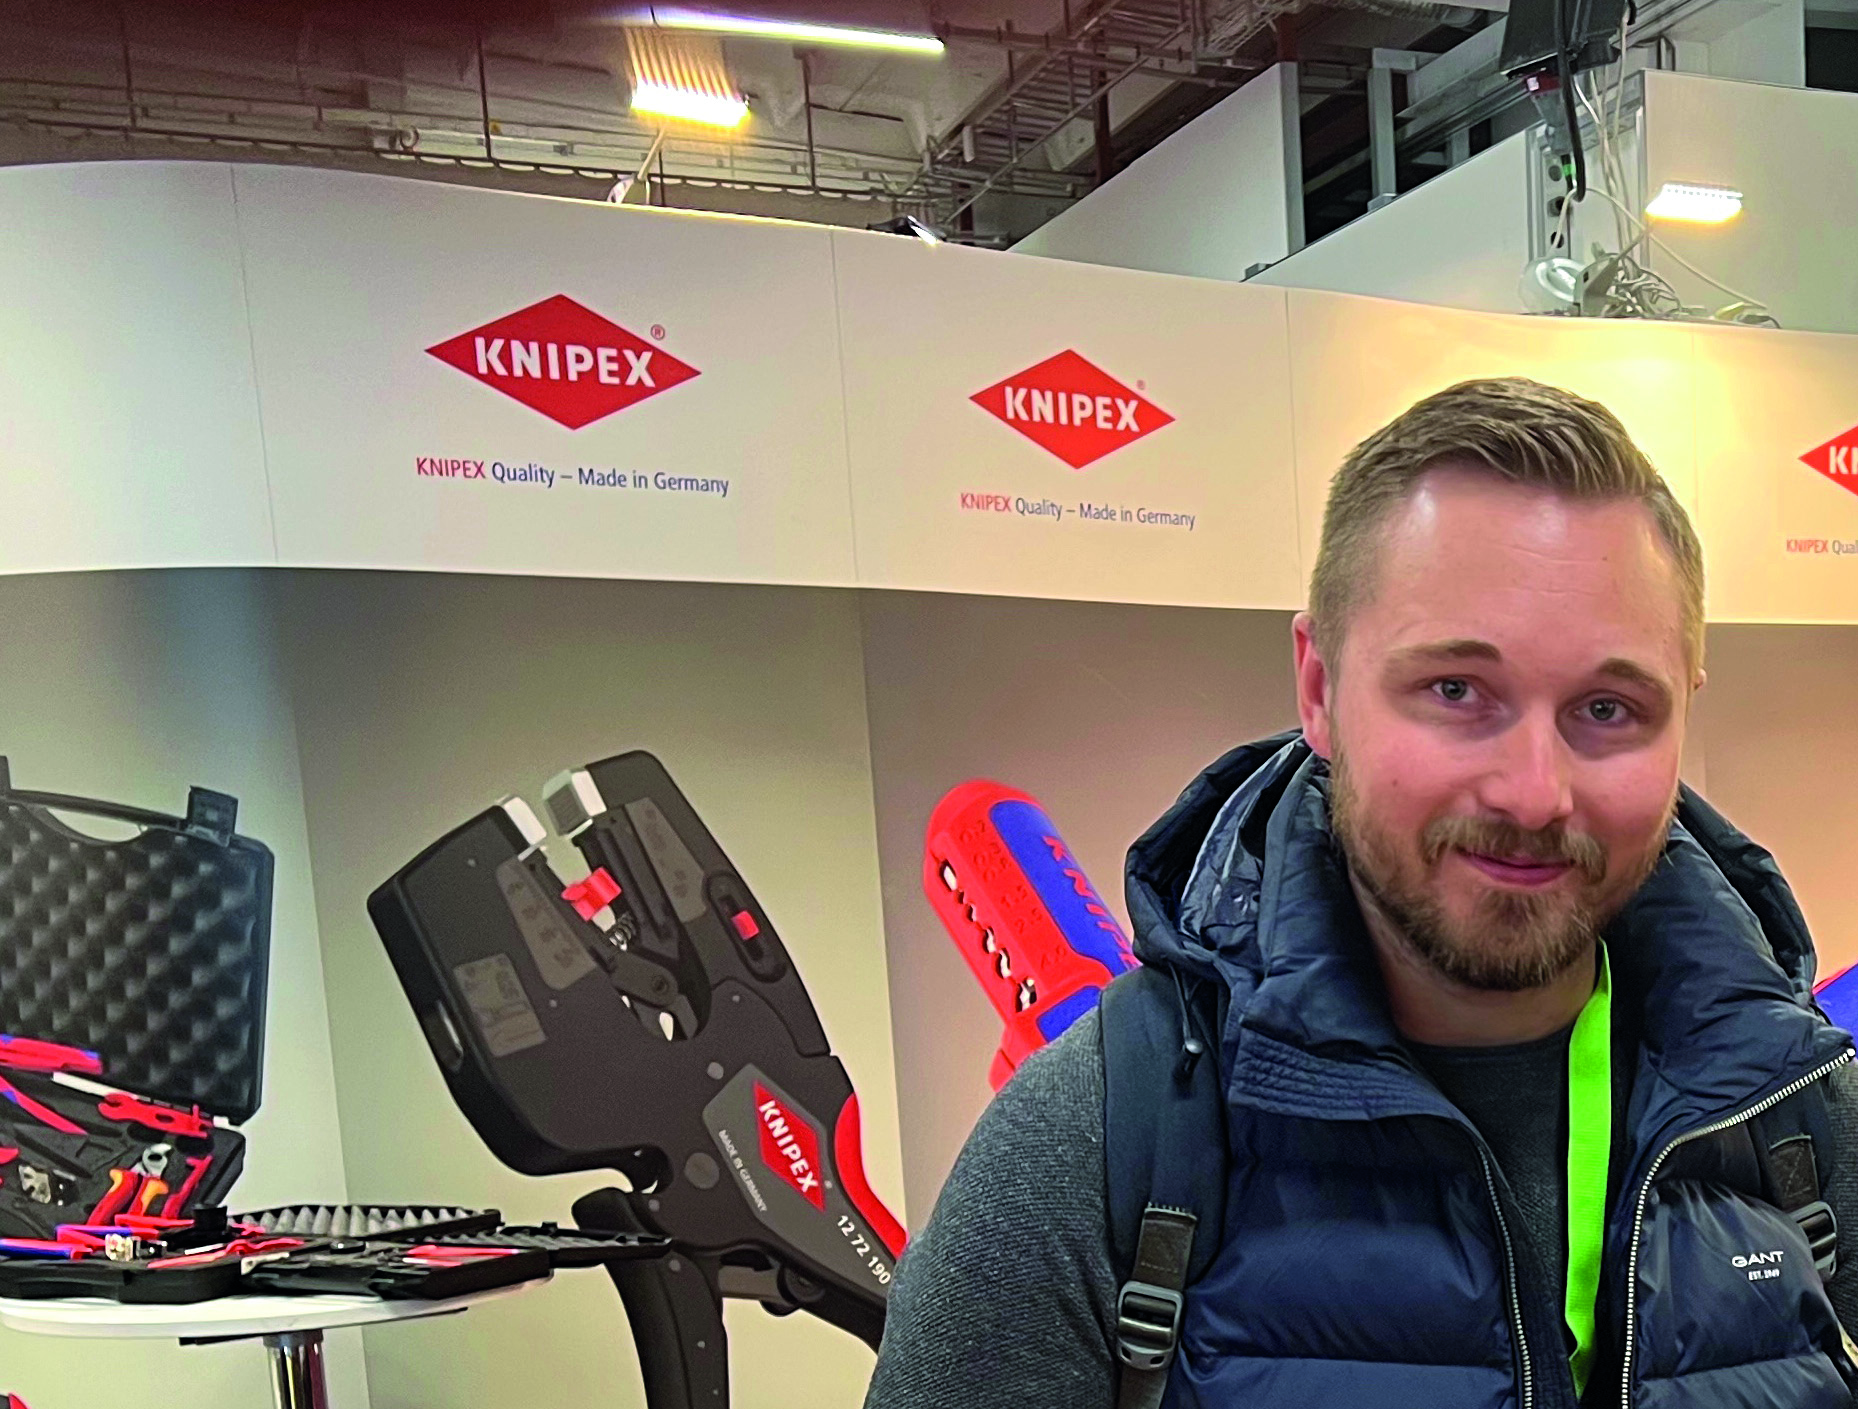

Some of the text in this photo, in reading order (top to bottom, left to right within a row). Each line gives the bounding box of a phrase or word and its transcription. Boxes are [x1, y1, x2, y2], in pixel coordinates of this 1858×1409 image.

[474, 336, 656, 387] KNIPEX
[1004, 385, 1140, 432] KNIPEX
[416, 457, 486, 479] KNIPEX
[491, 461, 555, 488] Quality
[578, 467, 627, 488] Made
[632, 469, 648, 489] in
[654, 471, 729, 498] Germany
[960, 492, 1012, 513] KNIPEX
[1015, 498, 1062, 522] Quality
[1079, 503, 1116, 521] Made
[1121, 505, 1133, 523] in
[1137, 507, 1196, 531] Germany
[1786, 539, 1829, 554] KNIPEX
[759, 1099, 819, 1193] KNIPEX
[837, 1215, 891, 1285] 12 72 190
[1731, 1250, 1784, 1268] GANT
